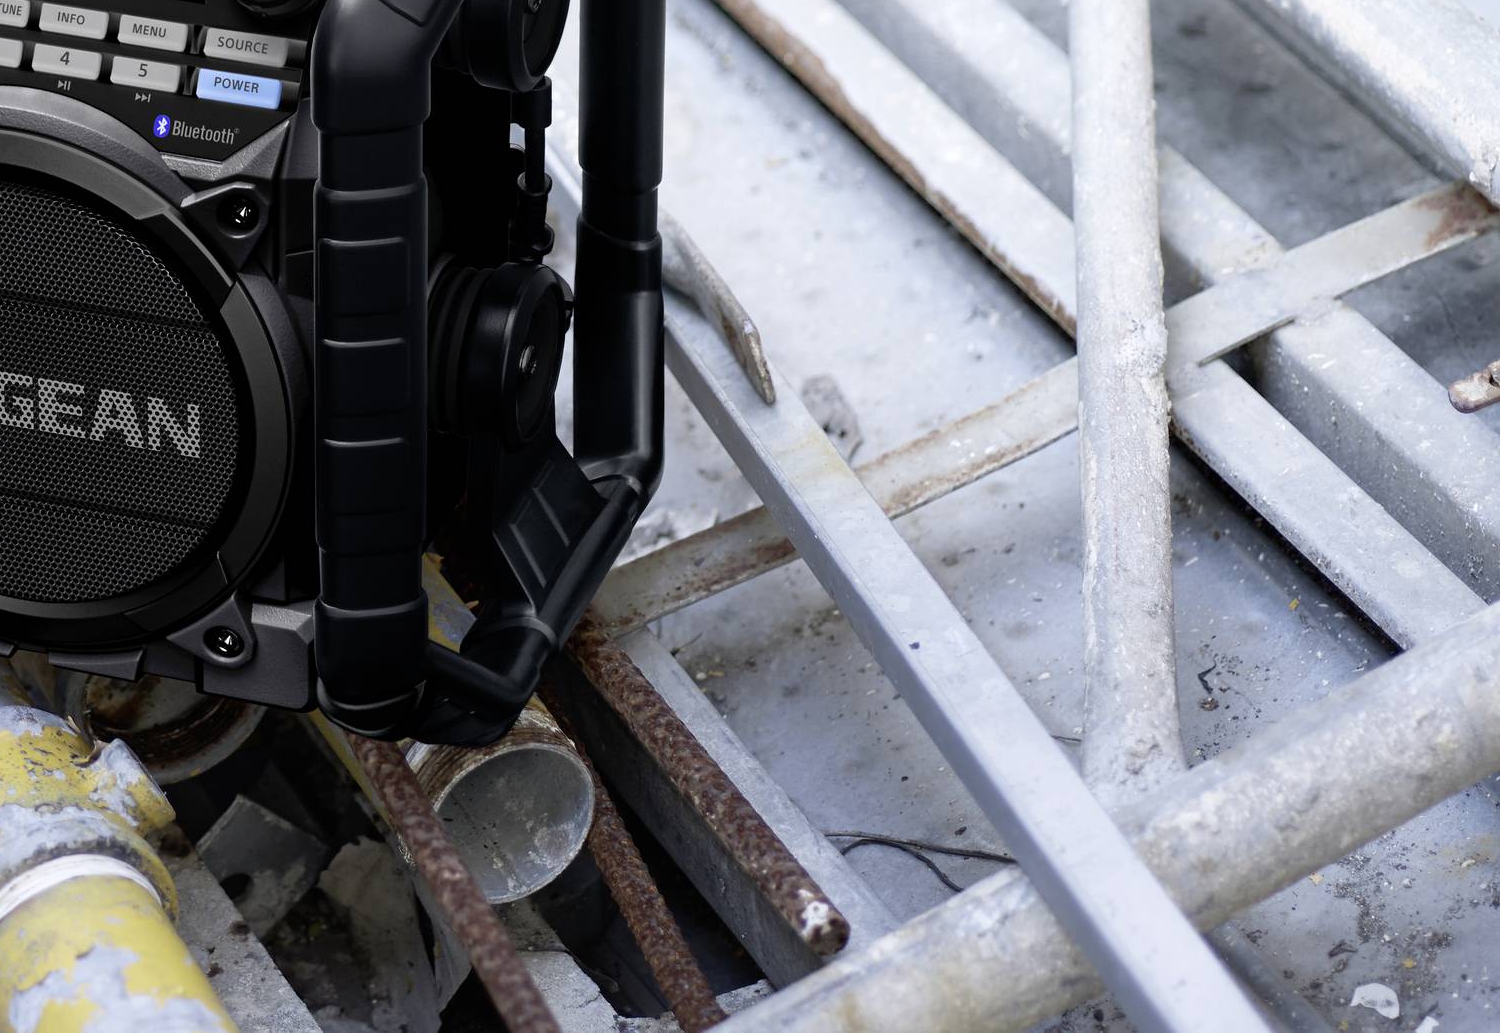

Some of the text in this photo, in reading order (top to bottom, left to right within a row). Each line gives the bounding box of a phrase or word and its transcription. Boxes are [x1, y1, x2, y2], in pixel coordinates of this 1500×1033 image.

[57, 11, 85, 25] INFO
[132, 23, 167, 38] MENU
[217, 36, 269, 54] SOURCE
[60, 51, 70, 65] 4
[138, 63, 148, 77] 5
[214, 76, 259, 93] POWER
